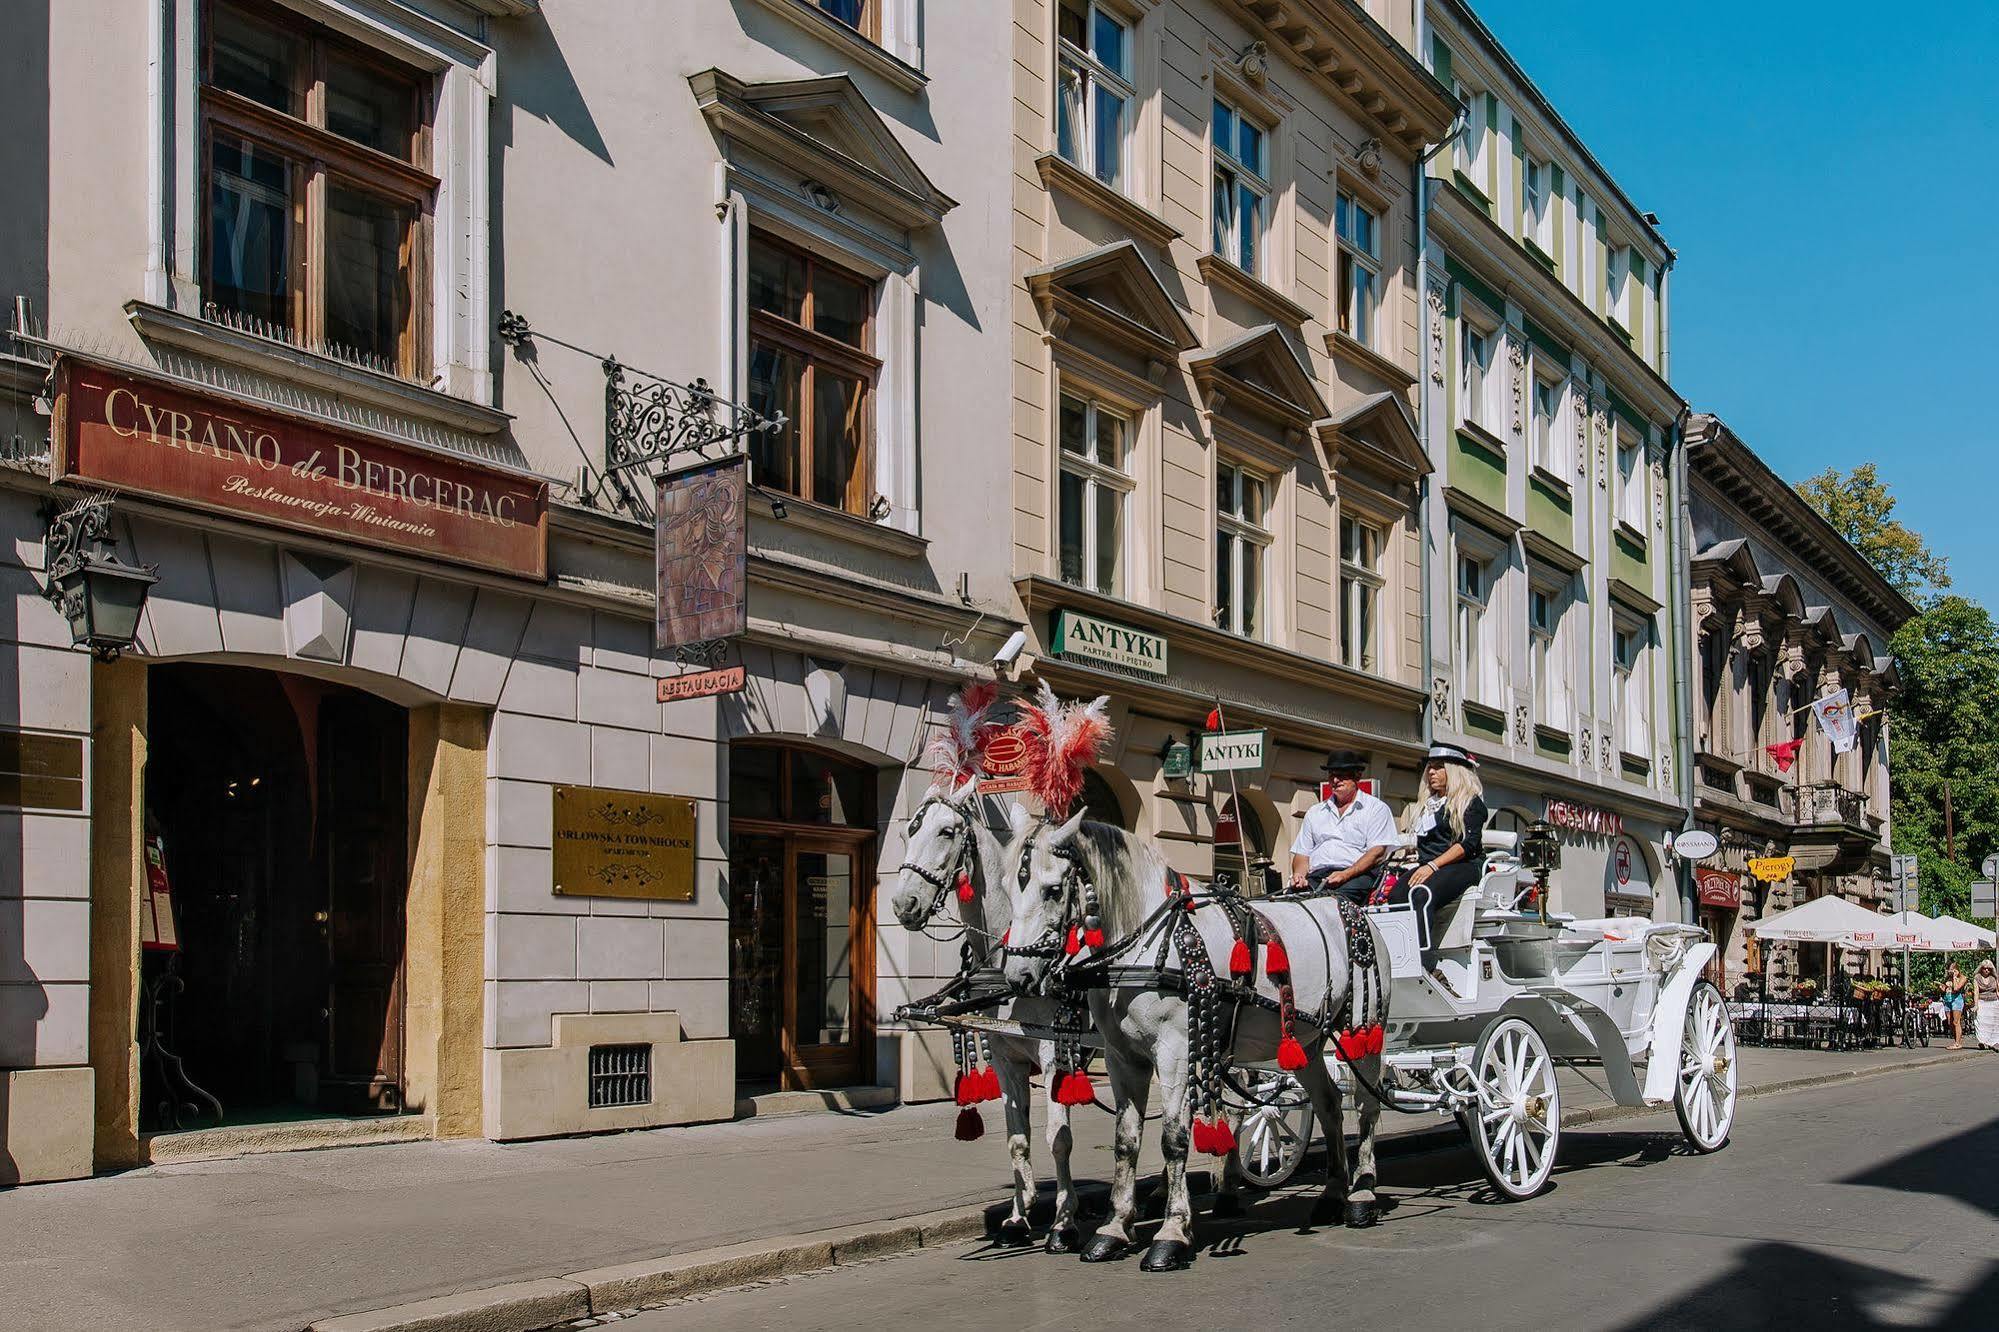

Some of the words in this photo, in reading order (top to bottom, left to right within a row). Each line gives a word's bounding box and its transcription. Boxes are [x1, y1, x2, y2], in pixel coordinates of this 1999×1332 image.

[105, 388, 281, 471] CYRANO
[291, 450, 327, 482] de
[334, 444, 516, 529] BERGERAC
[222, 475, 436, 538] Restauracja-Winiarnia
[1069, 618, 1162, 660] ANTYKI
[1083, 645, 1112, 659] PARTER
[662, 673, 739, 696] RESTAURACJA
[1204, 743, 1260, 761] ANTYKI
[983, 759, 997, 771] DEL
[1547, 799, 1625, 836] ROSSMANN
[557, 829, 622, 844] ORLOWSKA
[624, 833, 692, 849] TOWNHOUSE
